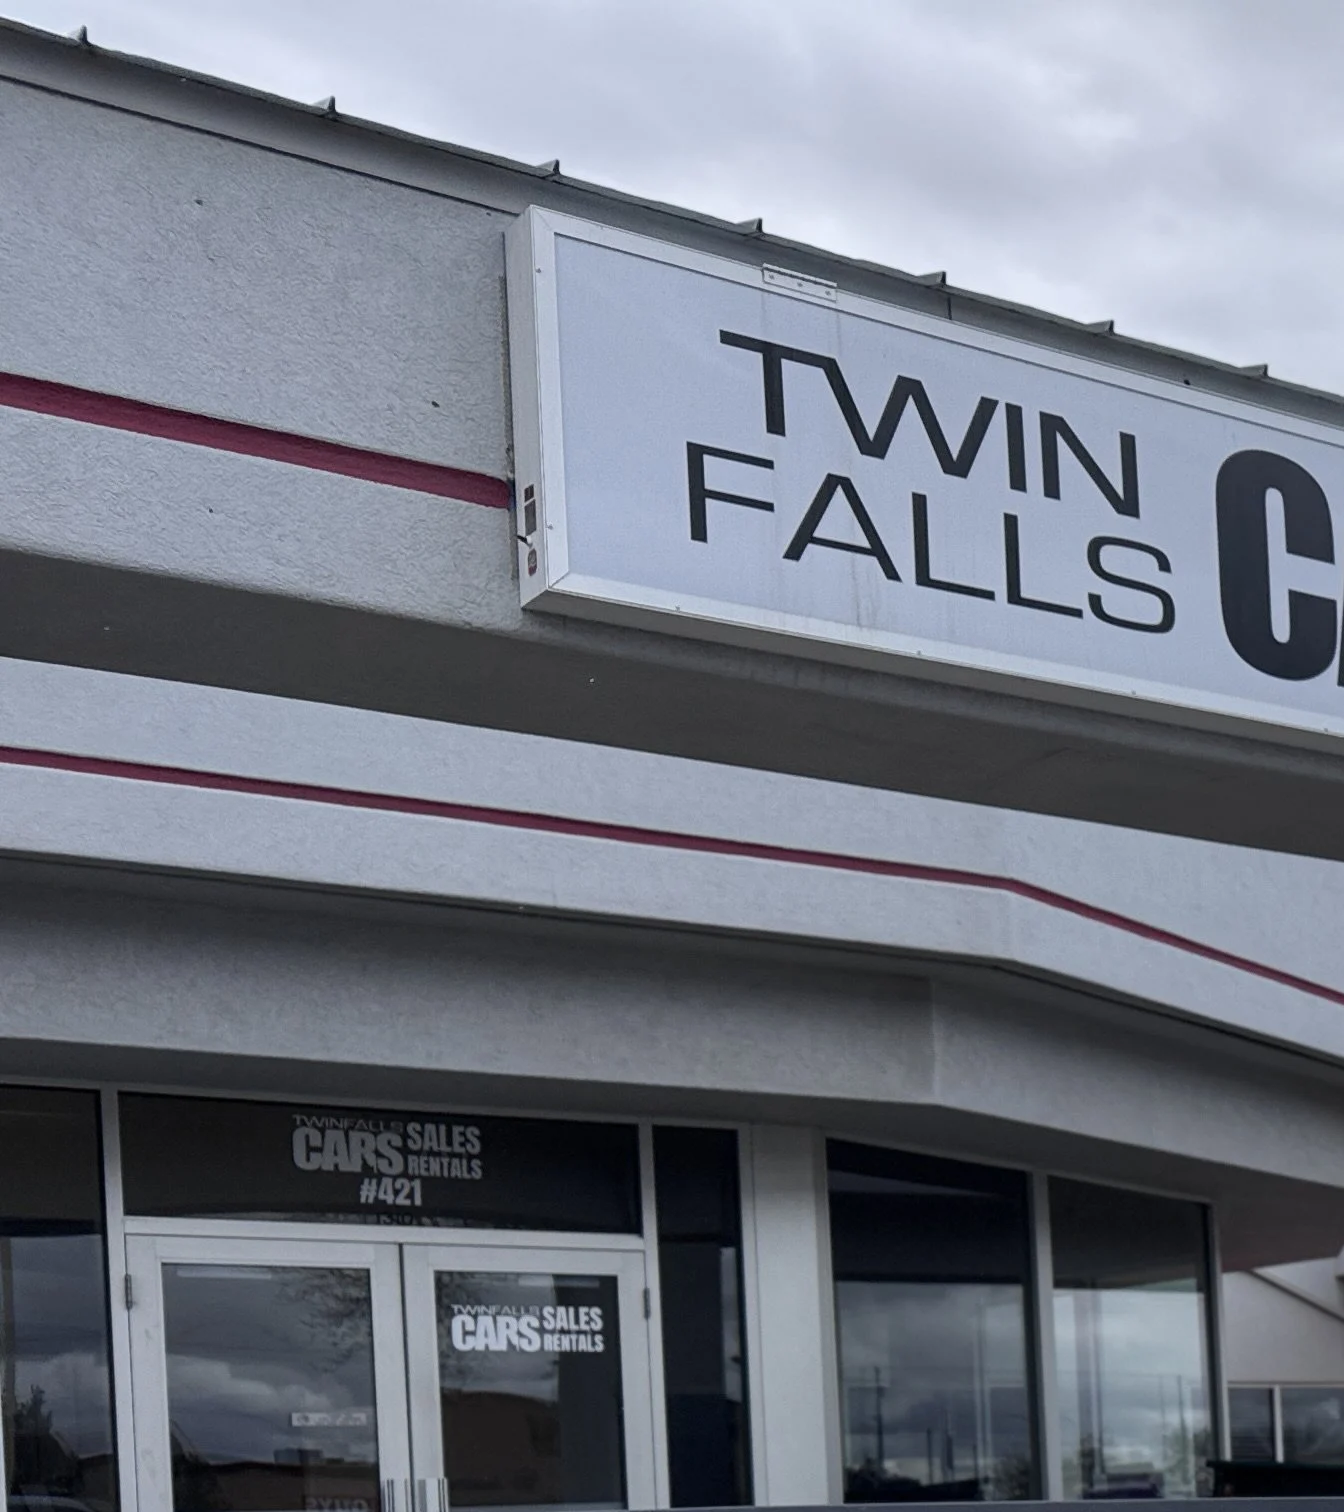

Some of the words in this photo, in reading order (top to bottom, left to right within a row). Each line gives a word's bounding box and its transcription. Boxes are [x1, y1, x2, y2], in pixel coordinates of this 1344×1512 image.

[719, 328, 1141, 520] TWIN
[685, 440, 1176, 635] FALLS
[291, 1125, 404, 1176] CARS
[406, 1121, 482, 1155] SALES
[407, 1155, 483, 1180] RENTALS
[359, 1177, 423, 1206] #421
[451, 1314, 541, 1353] CARS
[542, 1305, 604, 1331] SALES
[543, 1333, 604, 1353] RENTALS
